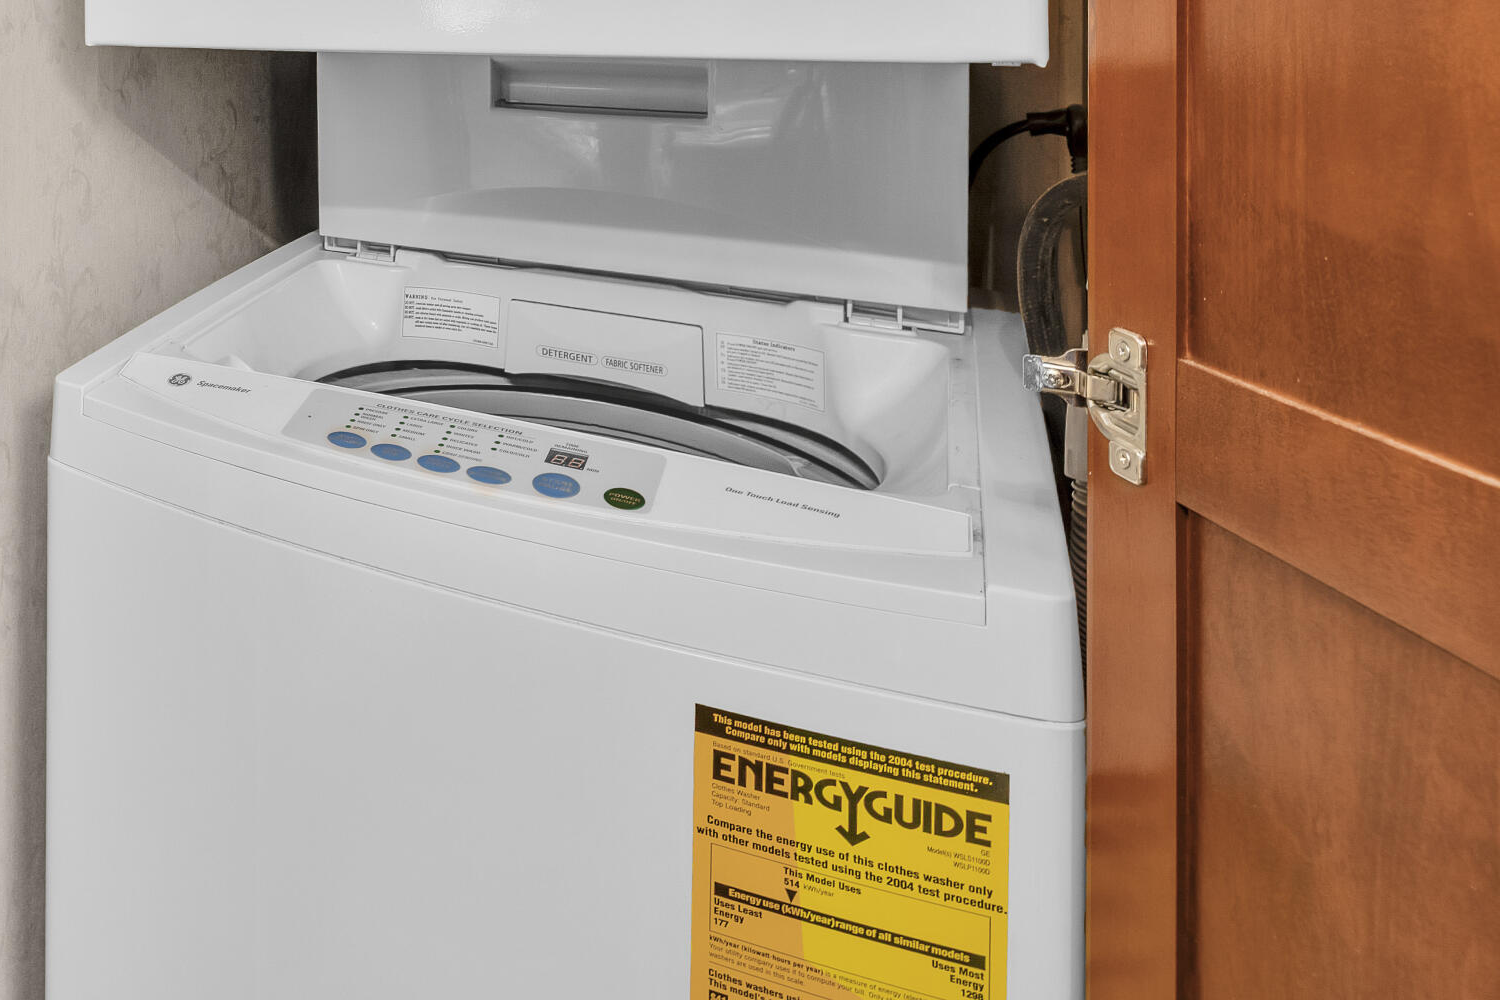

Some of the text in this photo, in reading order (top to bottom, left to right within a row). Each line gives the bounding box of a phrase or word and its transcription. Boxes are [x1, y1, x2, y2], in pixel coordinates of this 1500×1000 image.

[541, 347, 594, 364] DETERGENT
[605, 358, 664, 375] FABRIC SOFTENER
[197, 380, 251, 394] Spacemaker
[376, 403, 415, 415] CLOTHES
[416, 411, 441, 419] CARE
[442, 416, 469, 426] CYCLE
[472, 422, 523, 435] SELECTION
[609, 492, 641, 503] POWER
[725, 486, 841, 519] One Touch Load Sensing
[712, 713, 994, 786] This model has been tested using the 2004 test procedure.
[725, 726, 979, 793] Compare only with models displaying this statement.
[743, 748, 771, 761] standard
[787, 759, 828, 775] Government
[711, 783, 760, 800] Clothes Washer
[713, 748, 992, 848] ENERGYGUIDE
[711, 799, 752, 816] Top Loading
[741, 798, 770, 811] Standard
[707, 814, 993, 899] Compare the energy use of this clothes washer only
[697, 826, 1008, 915] with other models tested using the 2004 test procedure.
[783, 866, 862, 895] This Model Uses
[783, 877, 800, 889] 514
[713, 907, 744, 924] Energy
[714, 897, 763, 919] Uses Least
[713, 917, 729, 928] 177
[728, 887, 762, 906] Energy
[762, 899, 781, 911] use
[866, 928, 877, 938] of
[878, 932, 892, 942] all
[893, 935, 931, 952] similar
[931, 946, 970, 963] models
[709, 934, 739, 949] kWh/year
[793, 961, 804, 970] per
[838, 975, 868, 988] measure
[932, 959, 984, 980] Uses Most
[708, 968, 743, 986] Clothes
[745, 980, 784, 1000] washers
[708, 977, 727, 991] This
[744, 954, 774, 968] company
[837, 984, 853, 993] your
[949, 974, 985, 992] Energy
